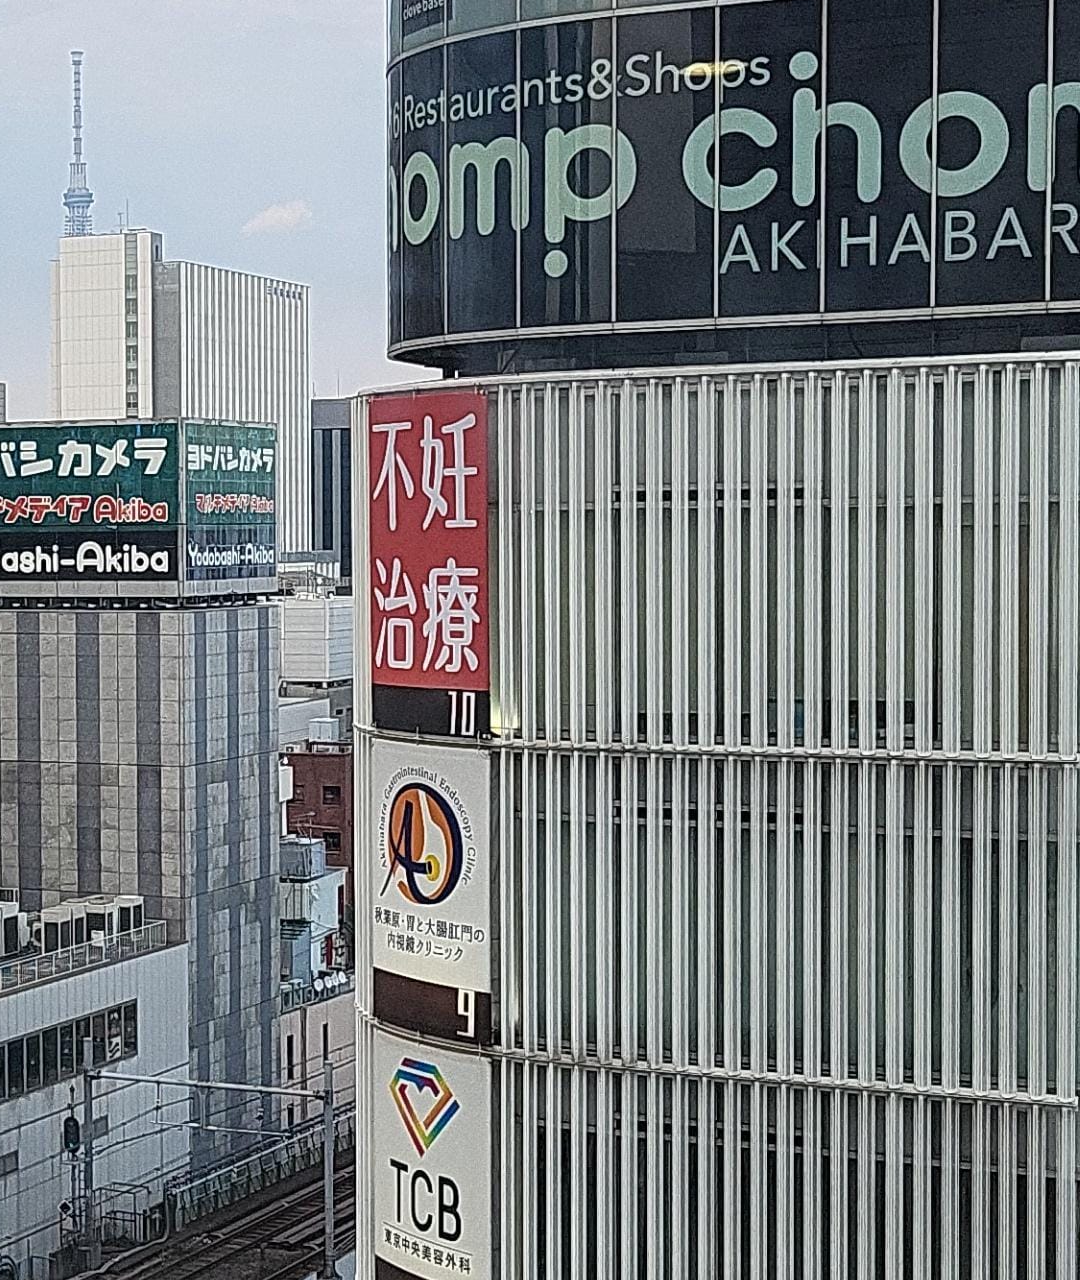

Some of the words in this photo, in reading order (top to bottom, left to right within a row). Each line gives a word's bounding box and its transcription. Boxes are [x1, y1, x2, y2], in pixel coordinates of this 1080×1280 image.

[390, 123, 637, 277] omp
[187, 444, 274, 473] ヨドバシカメラ
[372, 413, 478, 531] 不妊
[94, 496, 169, 524] Akiba
[187, 540, 274, 567] Yodobashi-Akiba
[374, 557, 480, 673] 治療
[448, 690, 475, 736] 10
[379, 803, 388, 868] Akihabara
[384, 766, 438, 800] Gastrointestinal
[439, 778, 474, 842] Endoscopy
[461, 846, 476, 886] Clinic
[387, 930, 463, 962] 内視鏡クリニック
[456, 988, 475, 1038] 9
[390, 1158, 462, 1242] TCB
[385, 1228, 471, 1274] 東京中央美容外科
